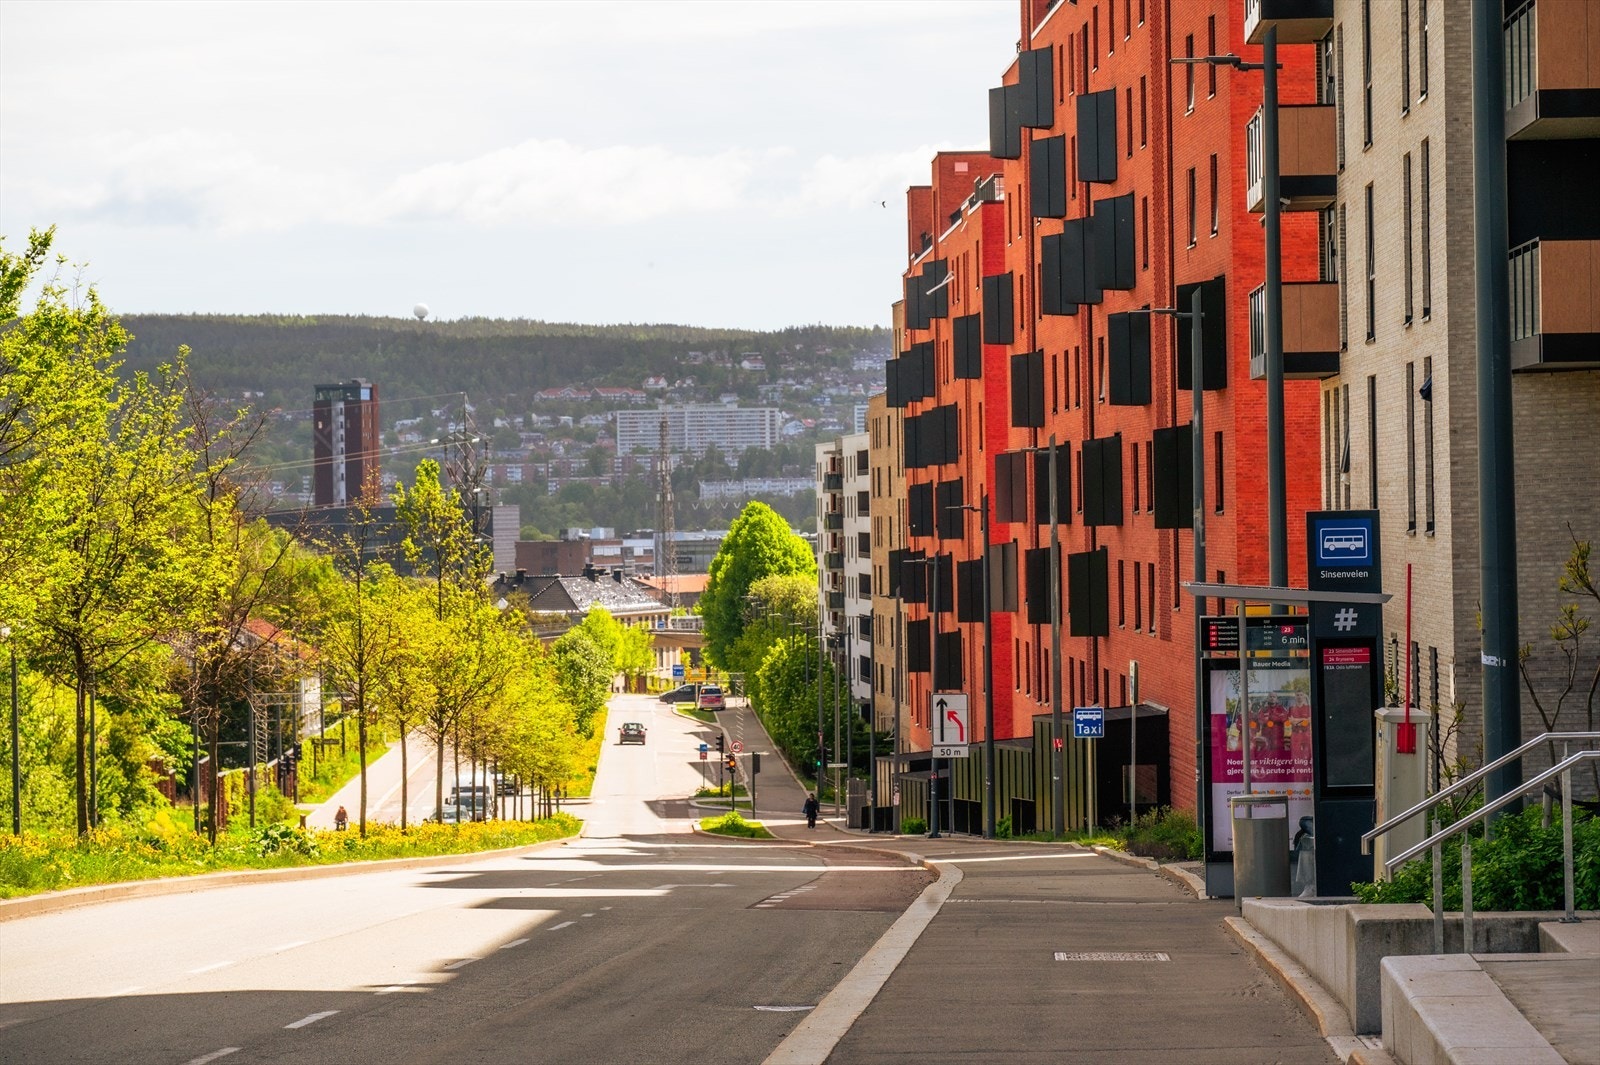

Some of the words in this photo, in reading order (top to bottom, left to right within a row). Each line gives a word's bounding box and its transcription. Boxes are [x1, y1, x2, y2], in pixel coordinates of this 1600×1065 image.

[1320, 570, 1369, 579] Sinsenveien
[1281, 635, 1288, 644] 6
[1289, 635, 1305, 644] min
[1077, 724, 1102, 734] Taxi
[940, 748, 951, 756] 50
[1259, 757, 1293, 767] viktigere
[1294, 758, 1309, 766] ting
[1286, 767, 1295, 775] på
